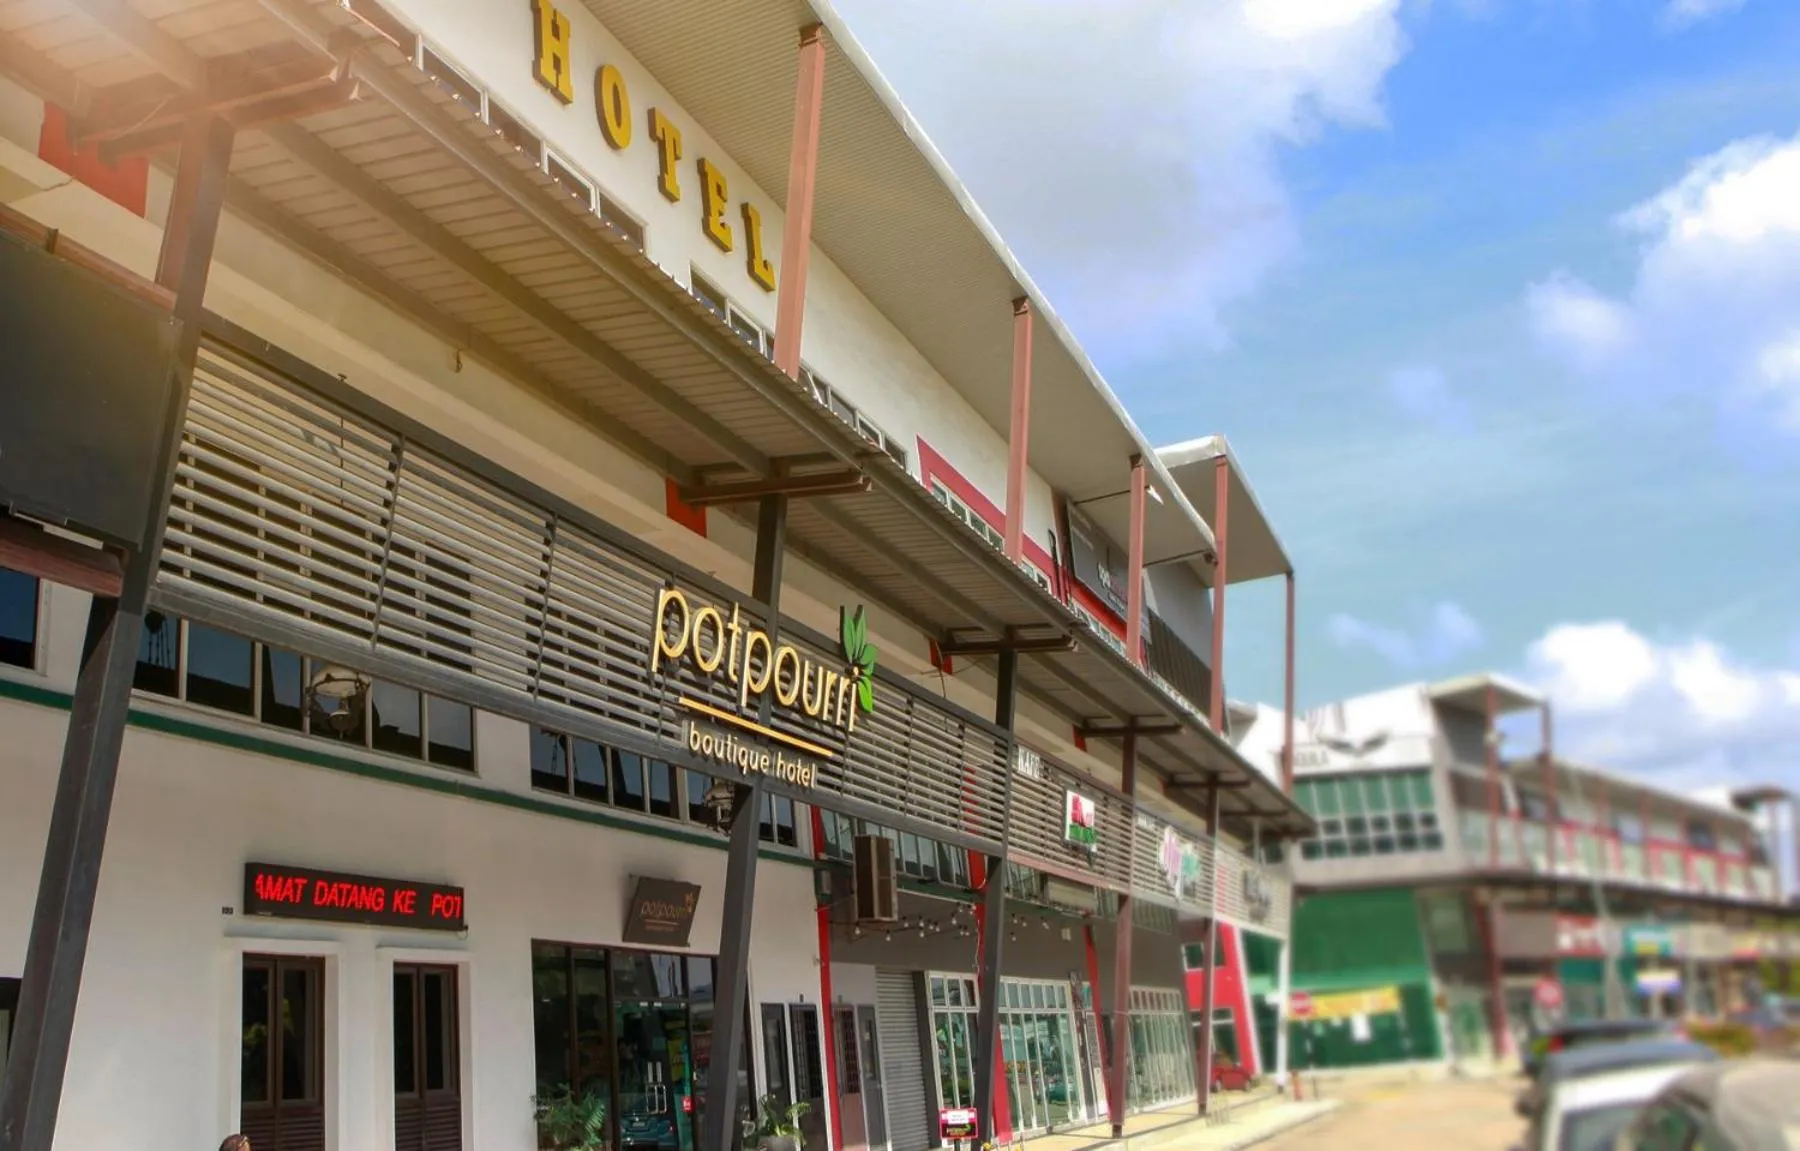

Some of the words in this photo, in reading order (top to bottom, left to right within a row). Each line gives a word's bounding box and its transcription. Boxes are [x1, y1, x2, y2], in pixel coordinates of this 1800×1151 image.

[531, 0, 776, 292] HOTEL
[651, 588, 859, 732] potpourri
[688, 721, 769, 774] boutique
[776, 751, 816, 789] hotel
[313, 880, 385, 912] DATANG
[393, 890, 417, 914] KE
